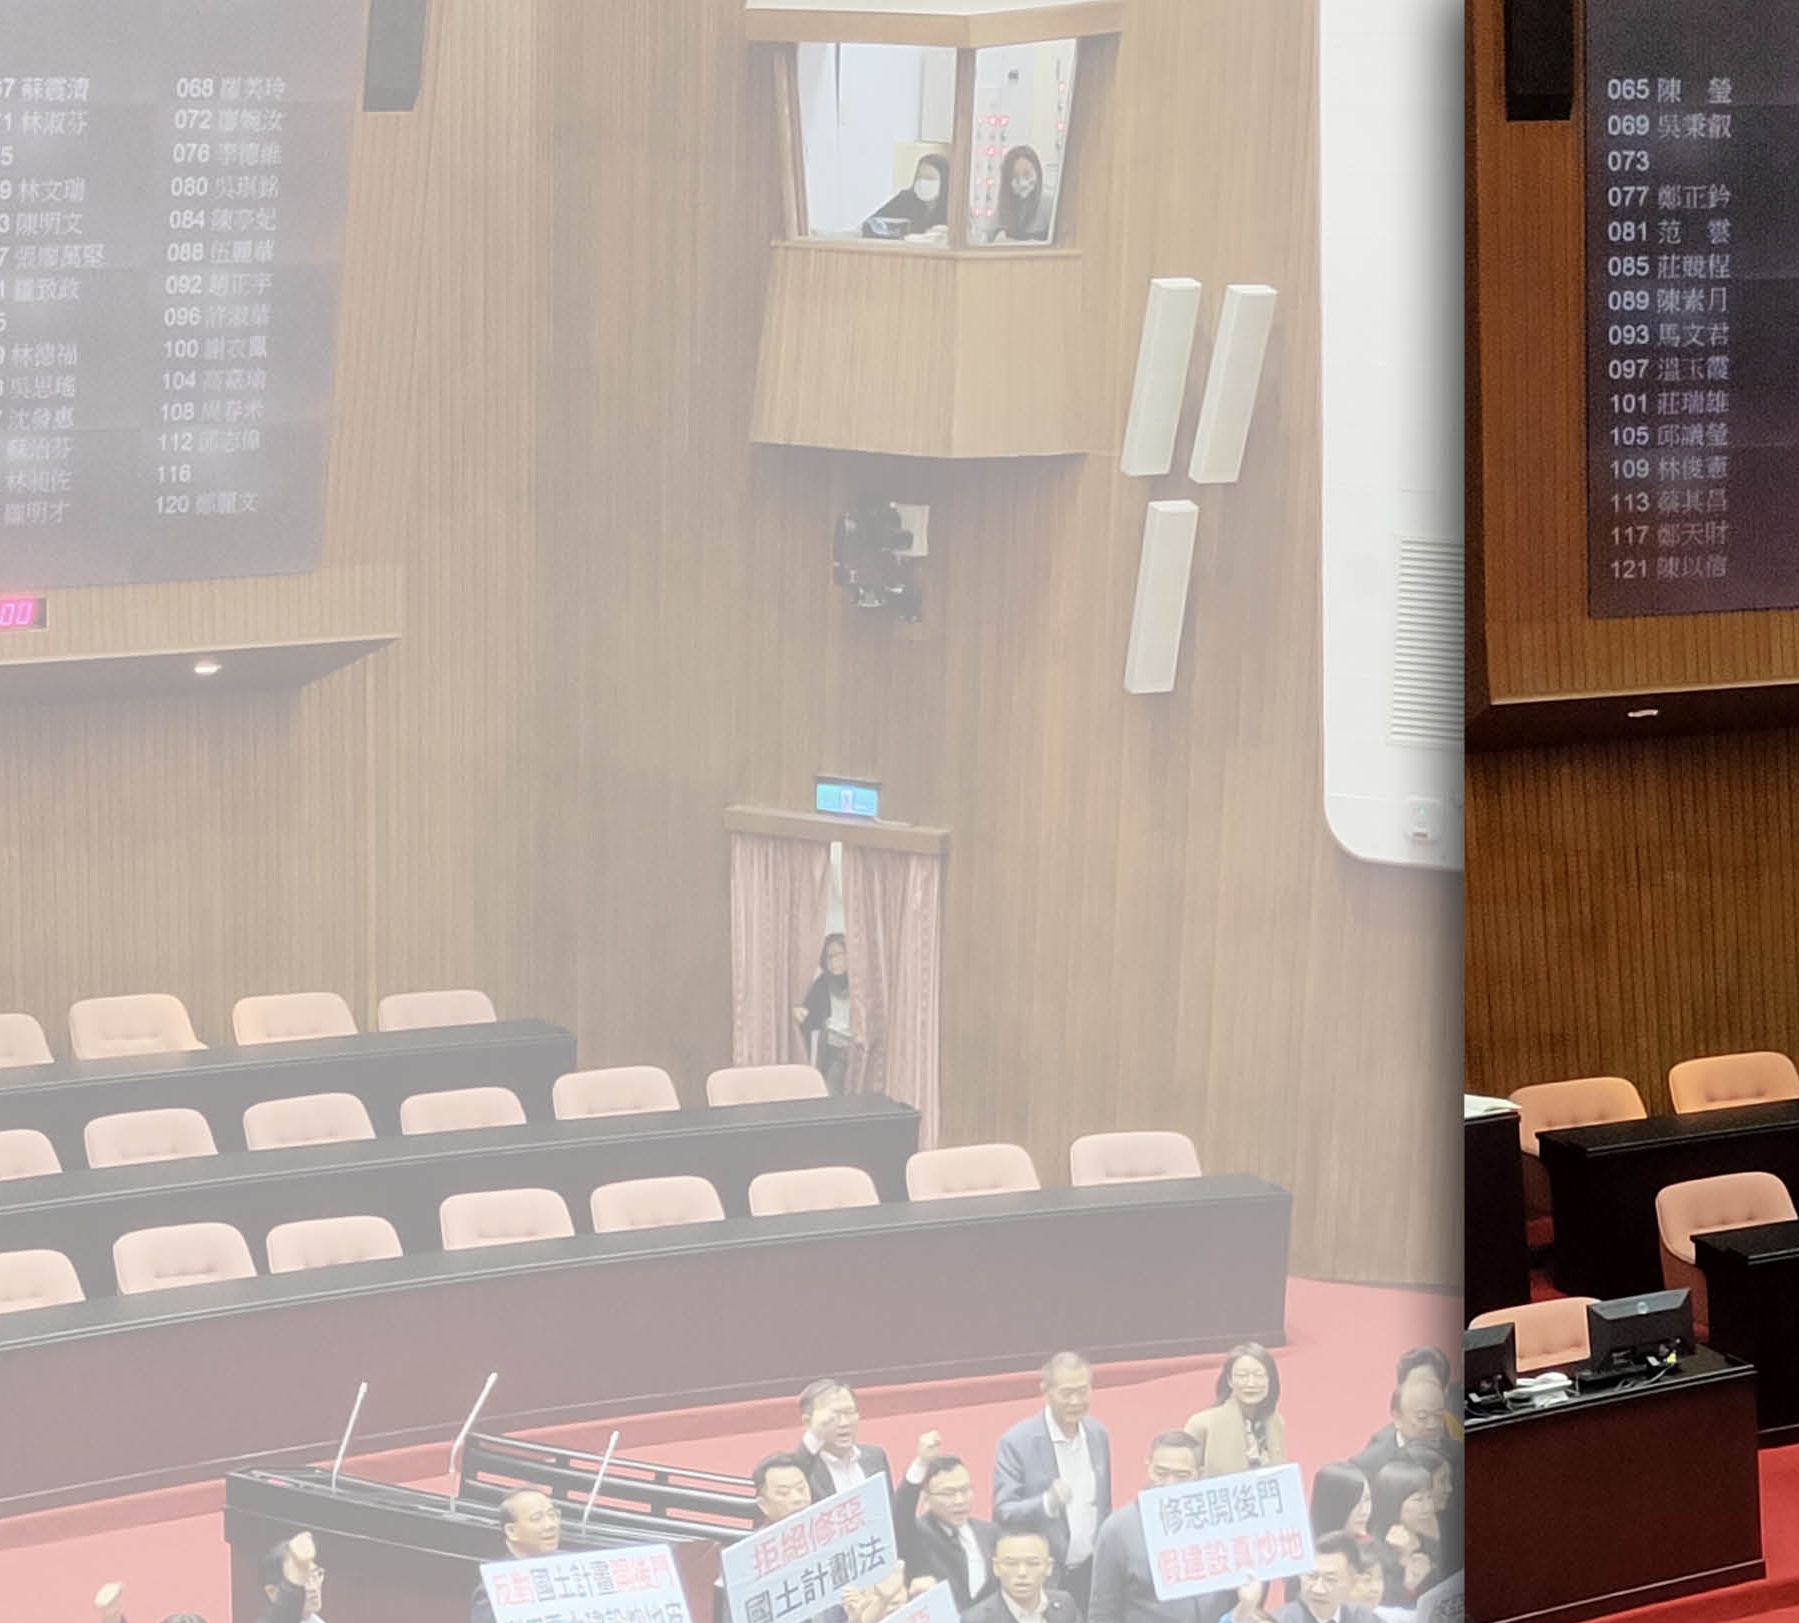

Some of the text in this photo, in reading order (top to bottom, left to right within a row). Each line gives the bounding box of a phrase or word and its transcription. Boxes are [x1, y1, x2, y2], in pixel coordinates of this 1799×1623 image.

[1608, 78, 1649, 99] 065
[1608, 115, 1649, 135] 069
[1608, 150, 1649, 171] 073
[1608, 186, 1649, 206] 077
[1608, 221, 1646, 241] 081
[1608, 256, 1649, 276] 085
[1608, 290, 1649, 310] 089
[1609, 325, 1649, 345] 093
[1609, 359, 1649, 379] 097
[1611, 394, 1646, 413] 101
[1611, 426, 1649, 445] 105
[1611, 459, 1649, 478] 109
[1611, 492, 1650, 512] 113
[1612, 525, 1649, 544] 117
[1611, 560, 1646, 578] 121
[0, 602, 33, 627] 00
[1158, 1478, 1283, 1537] 修惡開後門
[752, 1496, 863, 1581] 拒絕修惡
[1156, 1531, 1305, 1588] 假建設真炒地
